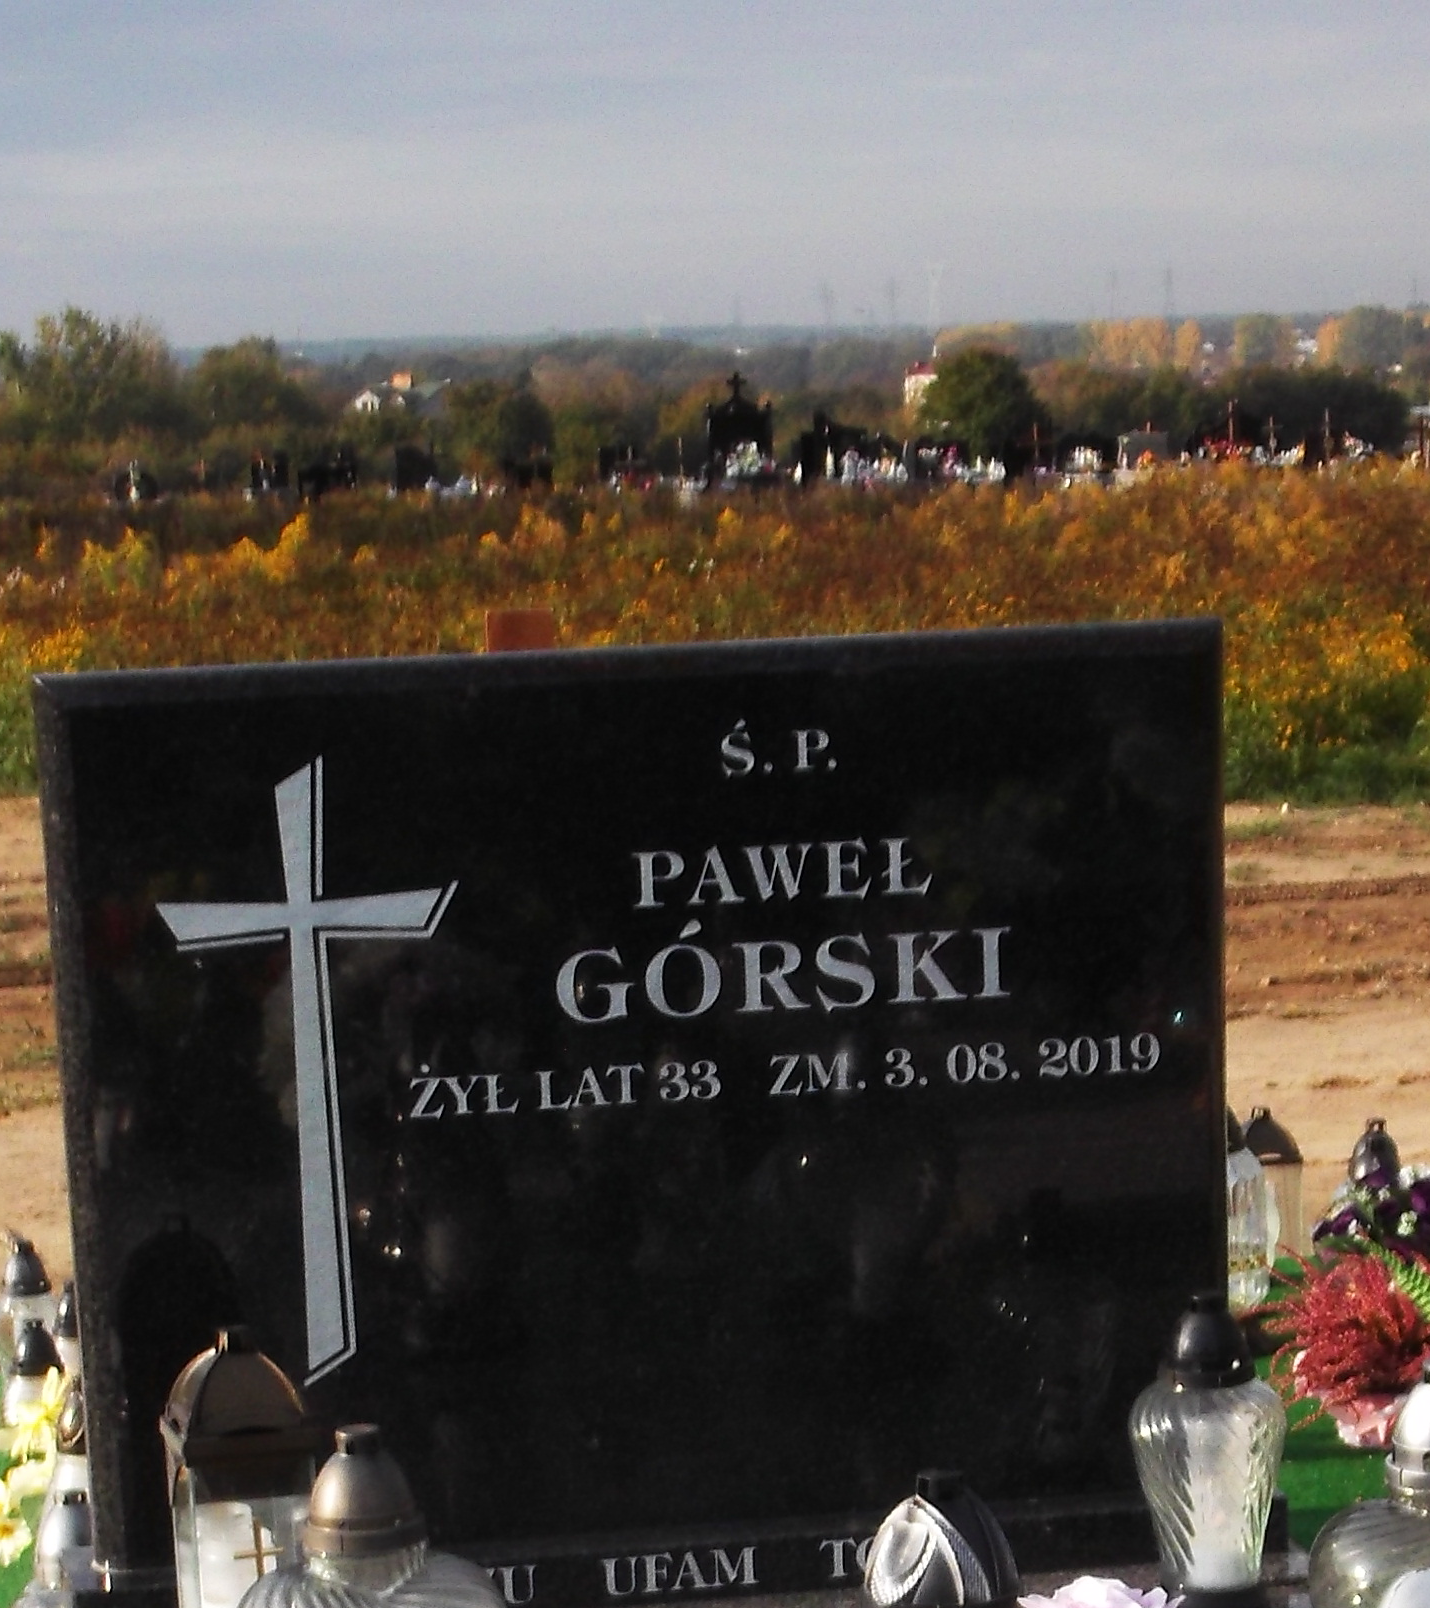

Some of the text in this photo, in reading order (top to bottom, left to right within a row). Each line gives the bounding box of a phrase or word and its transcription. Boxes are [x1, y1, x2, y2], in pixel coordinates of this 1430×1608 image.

[720, 720, 838, 777] Ś. P.
[632, 836, 933, 910] PAWEŁ
[556, 920, 1012, 1024] GÓRSKI
[409, 1033, 1162, 1121] ŻYŁ LAT 33 ZM. 3. 08. 2019
[487, 1564, 538, 1605] U
[605, 1545, 761, 1597] UFAM
